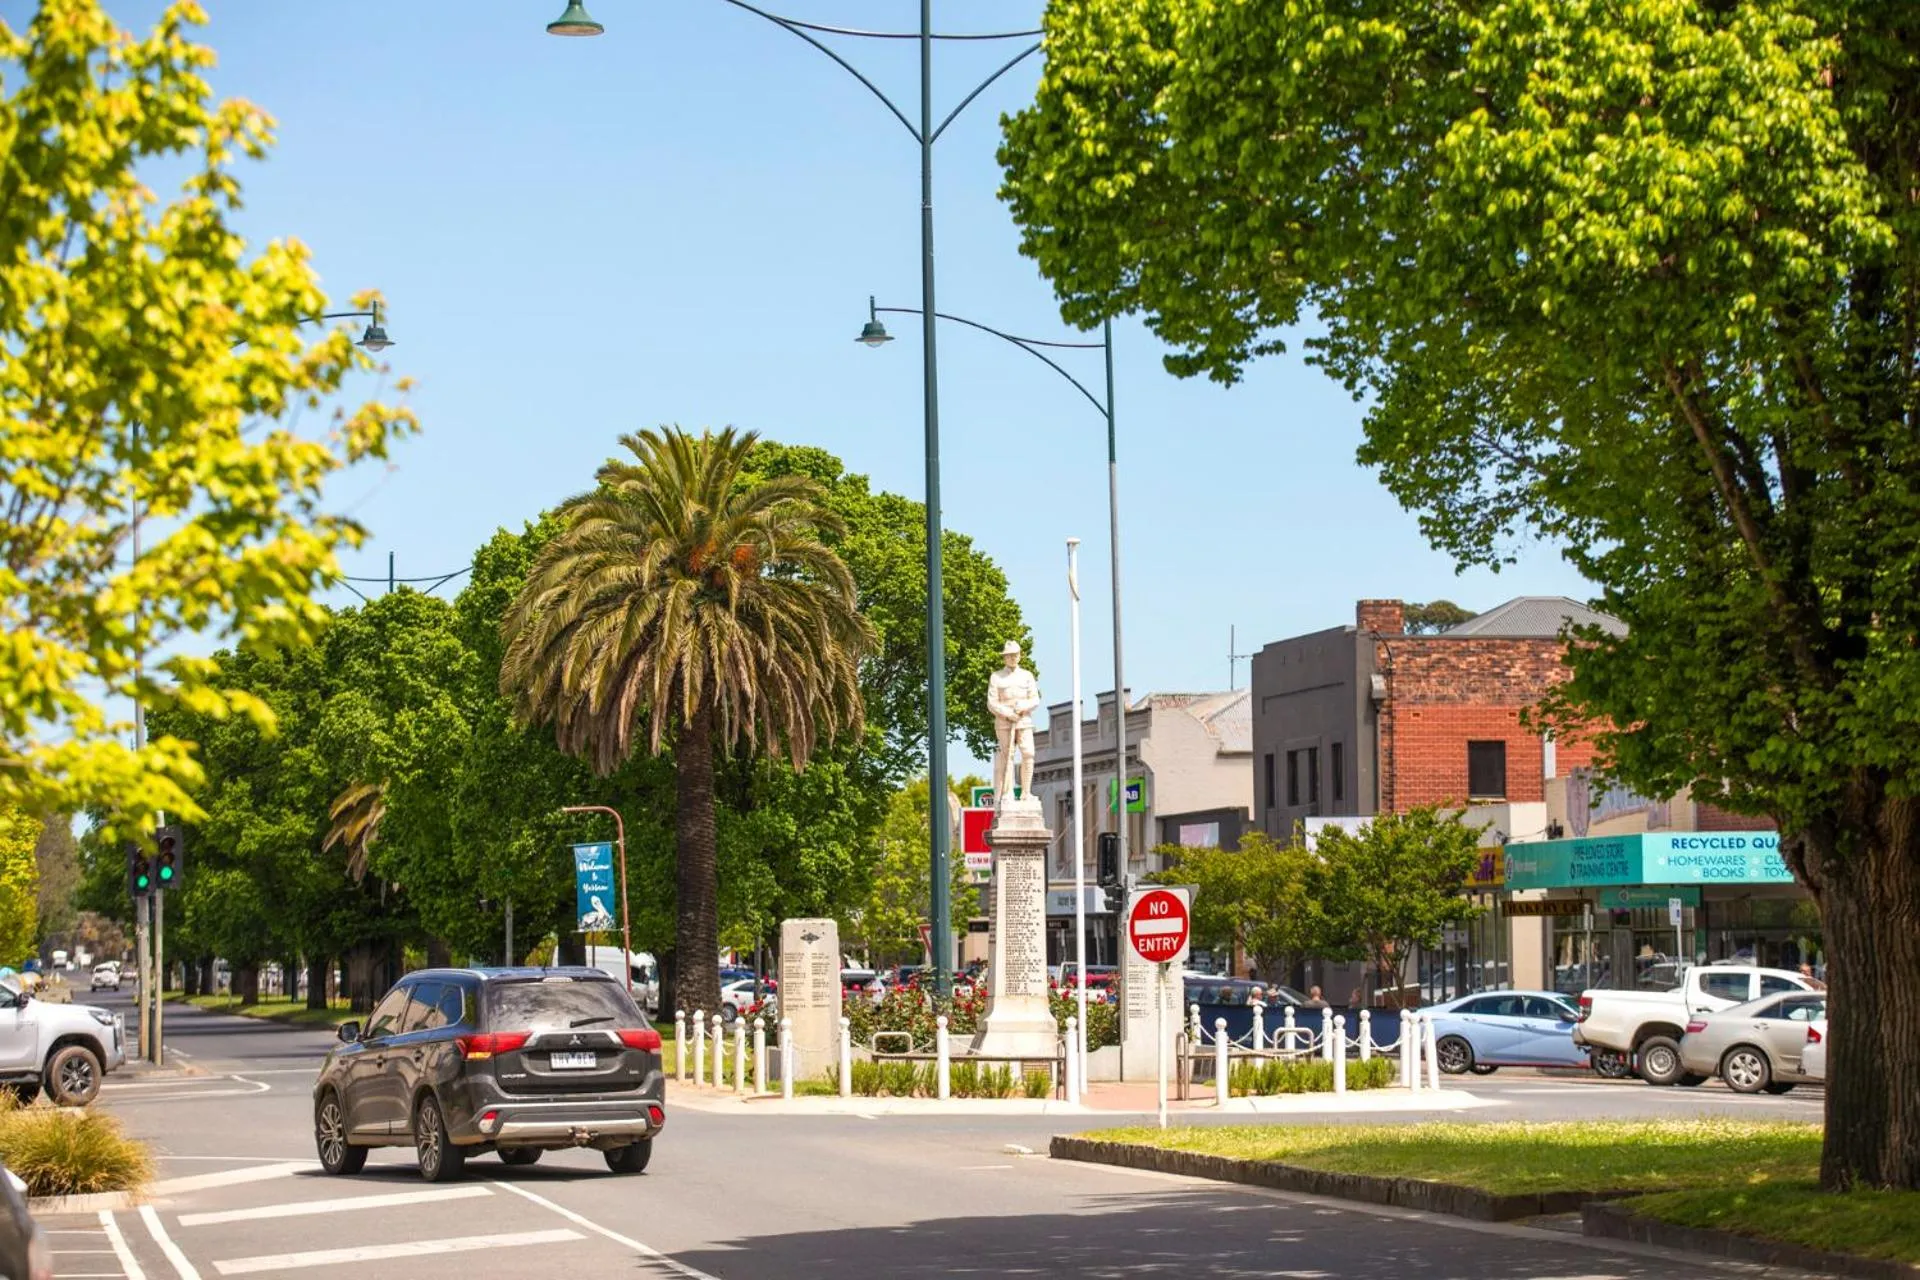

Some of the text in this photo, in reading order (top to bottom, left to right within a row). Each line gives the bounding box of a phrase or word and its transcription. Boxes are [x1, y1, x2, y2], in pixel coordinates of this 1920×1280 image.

[1671, 837, 1779, 849] RECYCLED QU
[1667, 855, 1746, 866] HOMEWARES
[1607, 860, 1629, 877] CENTRE
[1702, 867, 1745, 878] BOOKS
[1149, 901, 1169, 915] NO
[1138, 936, 1180, 952] ENTRY
